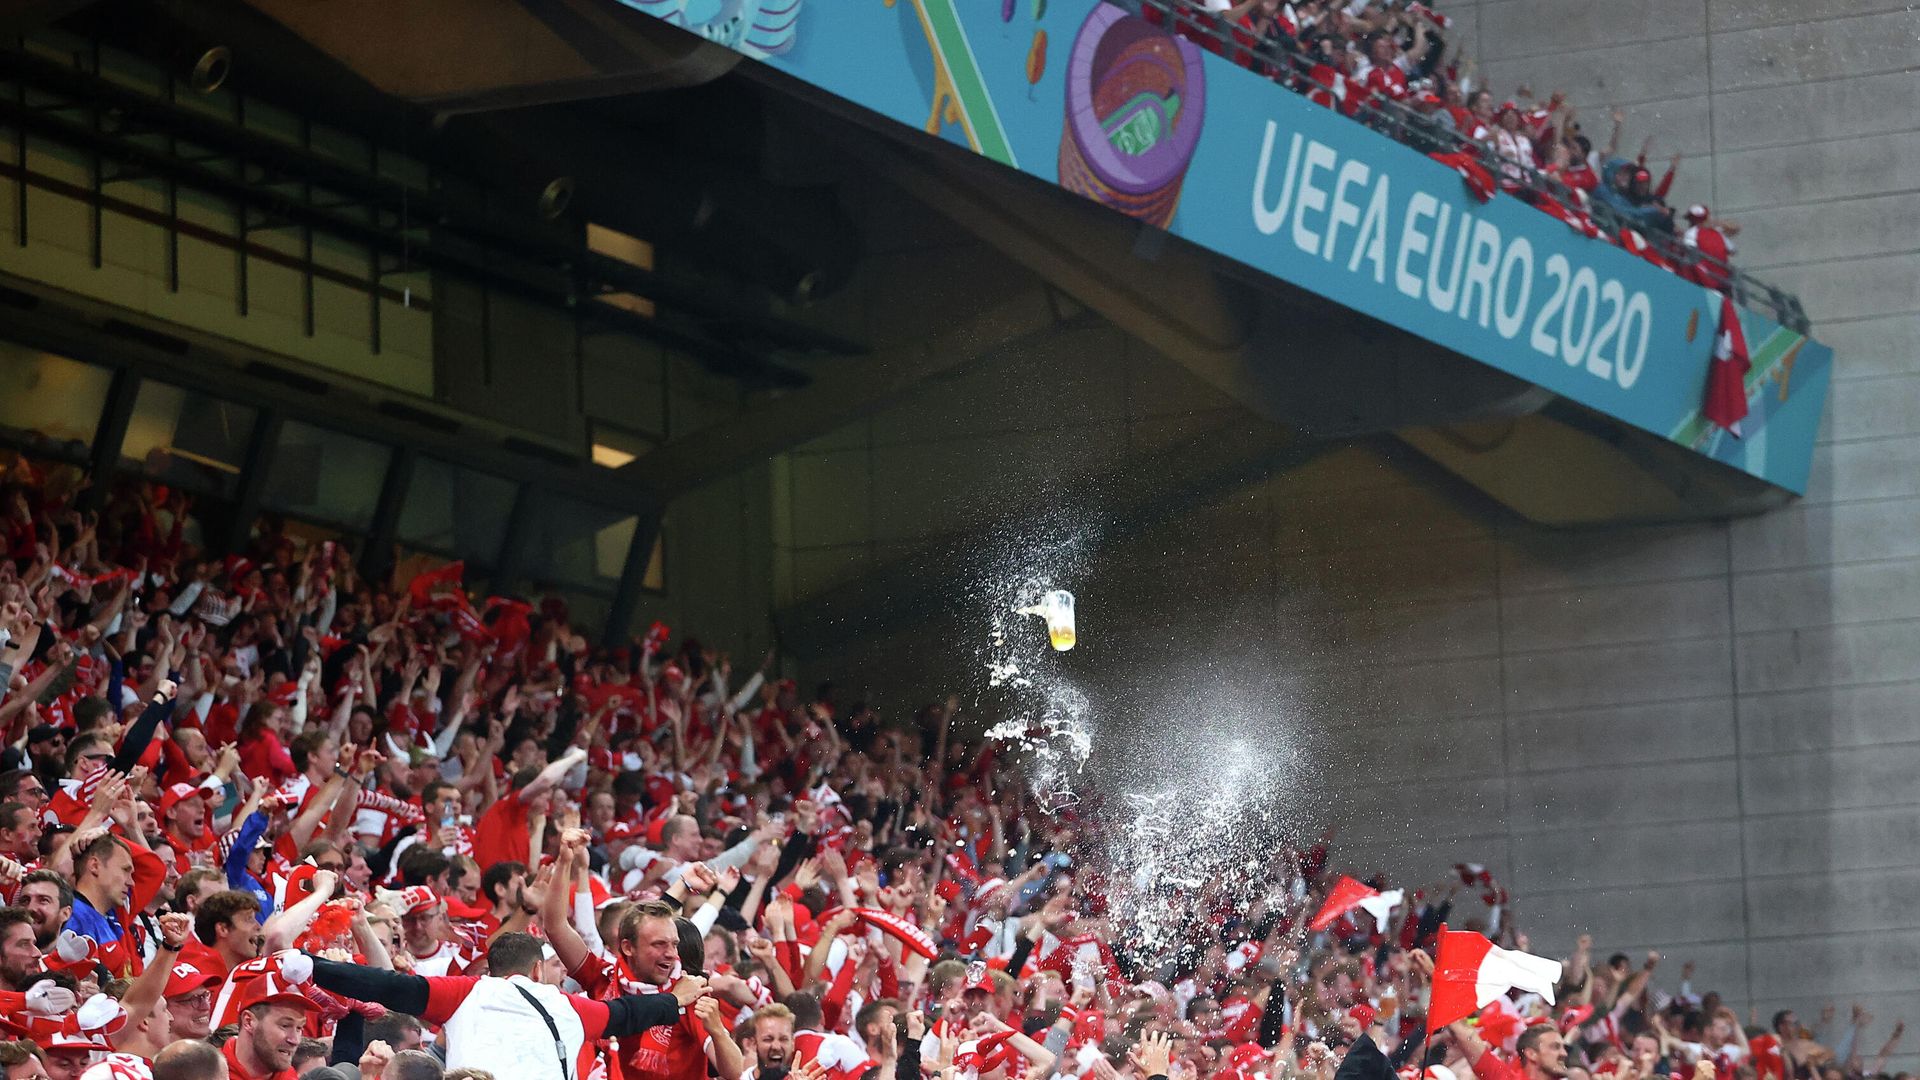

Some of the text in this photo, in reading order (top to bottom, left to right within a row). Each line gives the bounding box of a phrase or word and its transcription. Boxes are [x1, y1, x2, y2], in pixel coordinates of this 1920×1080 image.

[1252, 120, 1651, 389] UEFA EURO 2020
